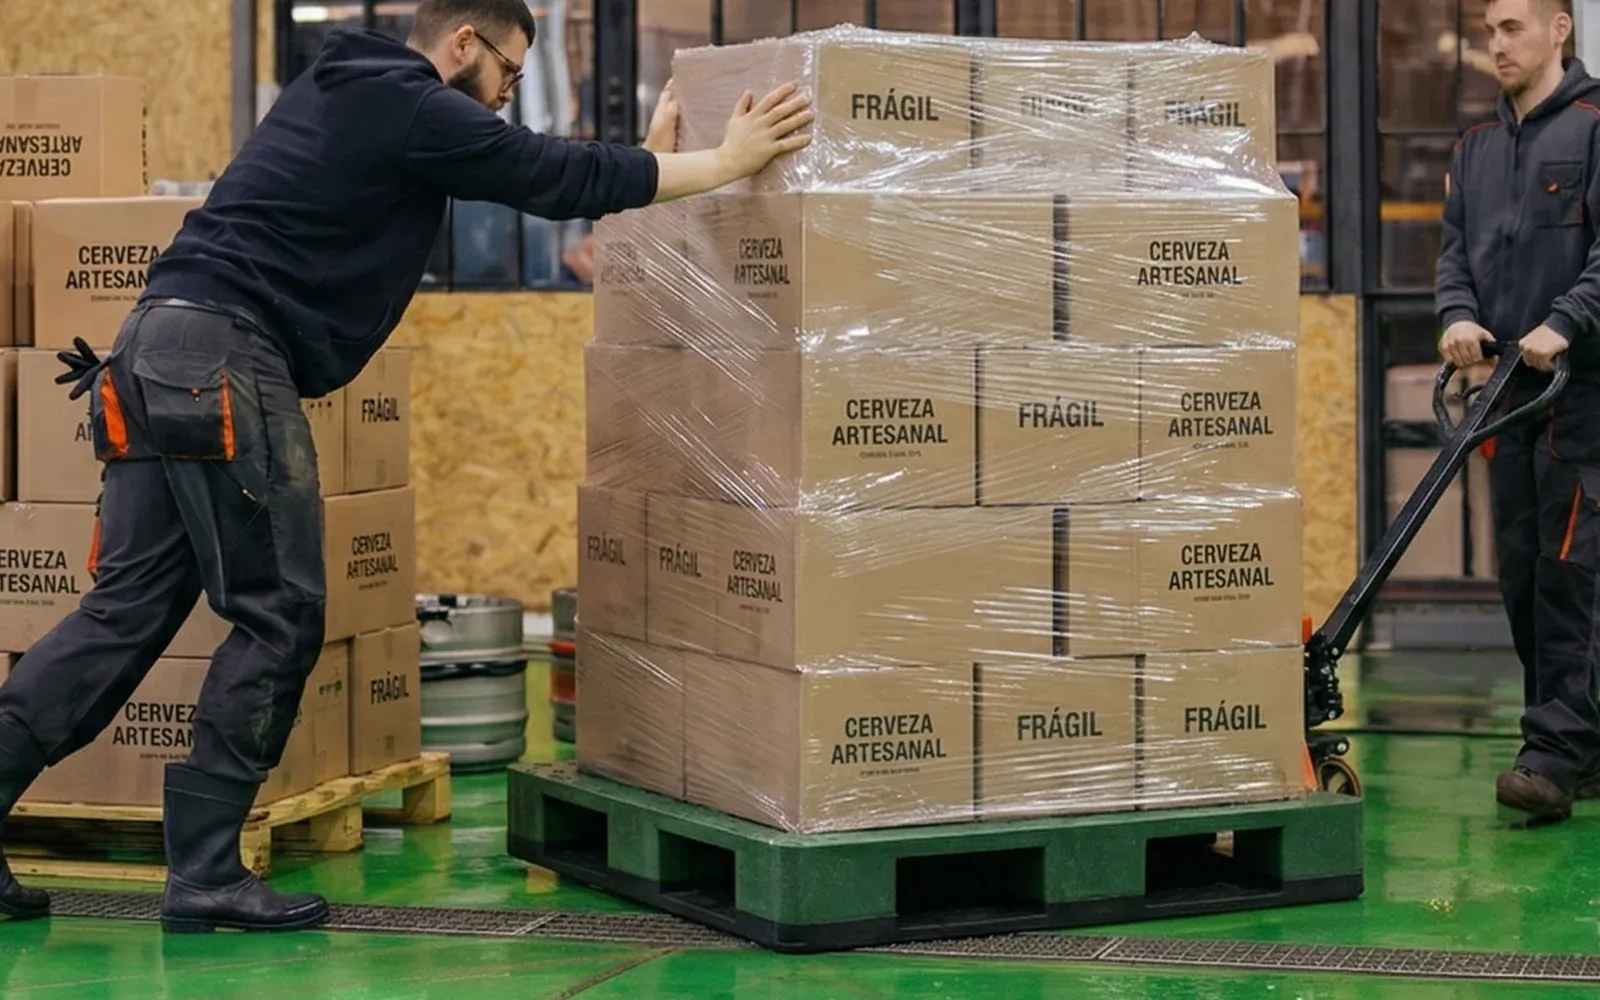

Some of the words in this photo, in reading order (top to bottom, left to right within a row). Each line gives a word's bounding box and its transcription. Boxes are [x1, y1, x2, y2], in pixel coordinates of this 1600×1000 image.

[851, 87, 939, 122] FRÁGIL
[740, 237, 783, 260] CERVEZA
[1149, 241, 1230, 262] CERVEZA
[65, 269, 149, 289] ARTESAN
[735, 263, 790, 285] ARTESANAL
[1137, 265, 1242, 286] ARTESANAL
[846, 398, 935, 420] CERVEZA
[1019, 396, 1105, 429] FRÁGIL
[1180, 391, 1262, 412] CERVEZA
[832, 423, 948, 446] ARTESANAL
[1168, 415, 1274, 438] ARTESANAL
[0, 549, 67, 570] ERVEZA
[587, 532, 626, 566] FRÁGIL
[659, 543, 702, 578] FRÁGIL
[1181, 542, 1262, 566] CERVEZA
[733, 550, 776, 575] CERVEZA
[0, 573, 81, 594] TESANAL
[726, 571, 783, 603] ARTESANAL
[1168, 567, 1274, 591] ARTESANAL
[370, 671, 410, 704] FRÁGIL
[125, 702, 197, 723] CERVEZ
[1017, 706, 1103, 741] FRÁGIL
[1184, 699, 1267, 733] FRÁGIL
[845, 713, 934, 739] CERVEZA
[831, 739, 947, 765] ARTESANAL
